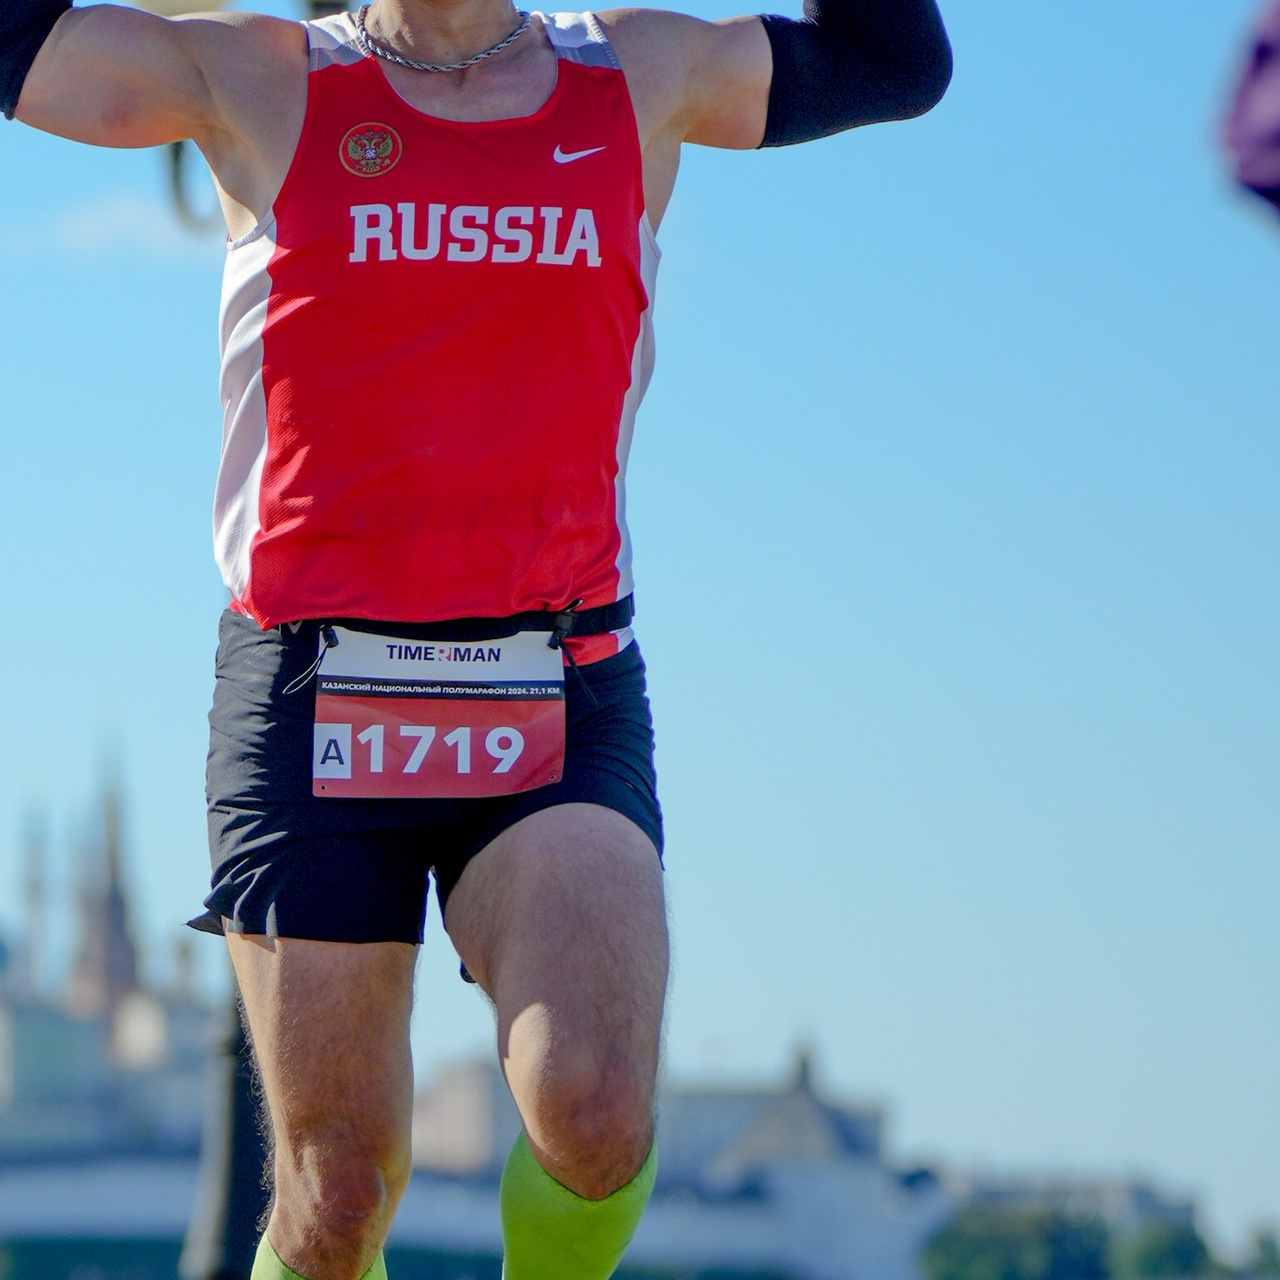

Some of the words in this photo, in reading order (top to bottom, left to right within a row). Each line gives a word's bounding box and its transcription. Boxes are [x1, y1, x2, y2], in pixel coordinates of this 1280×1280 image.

[348, 202, 603, 268] RUSSIA
[321, 681, 371, 691] КАЗАНСКИЙ
[371, 684, 441, 693] НАЦИОНАЛЬНЫЙ
[442, 686, 507, 695] ПОЛУМАРАФОН
[507, 687, 529, 695] 2024.
[529, 687, 546, 696] 21,1
[319, 738, 345, 766] A
[356, 724, 524, 774] 1719
